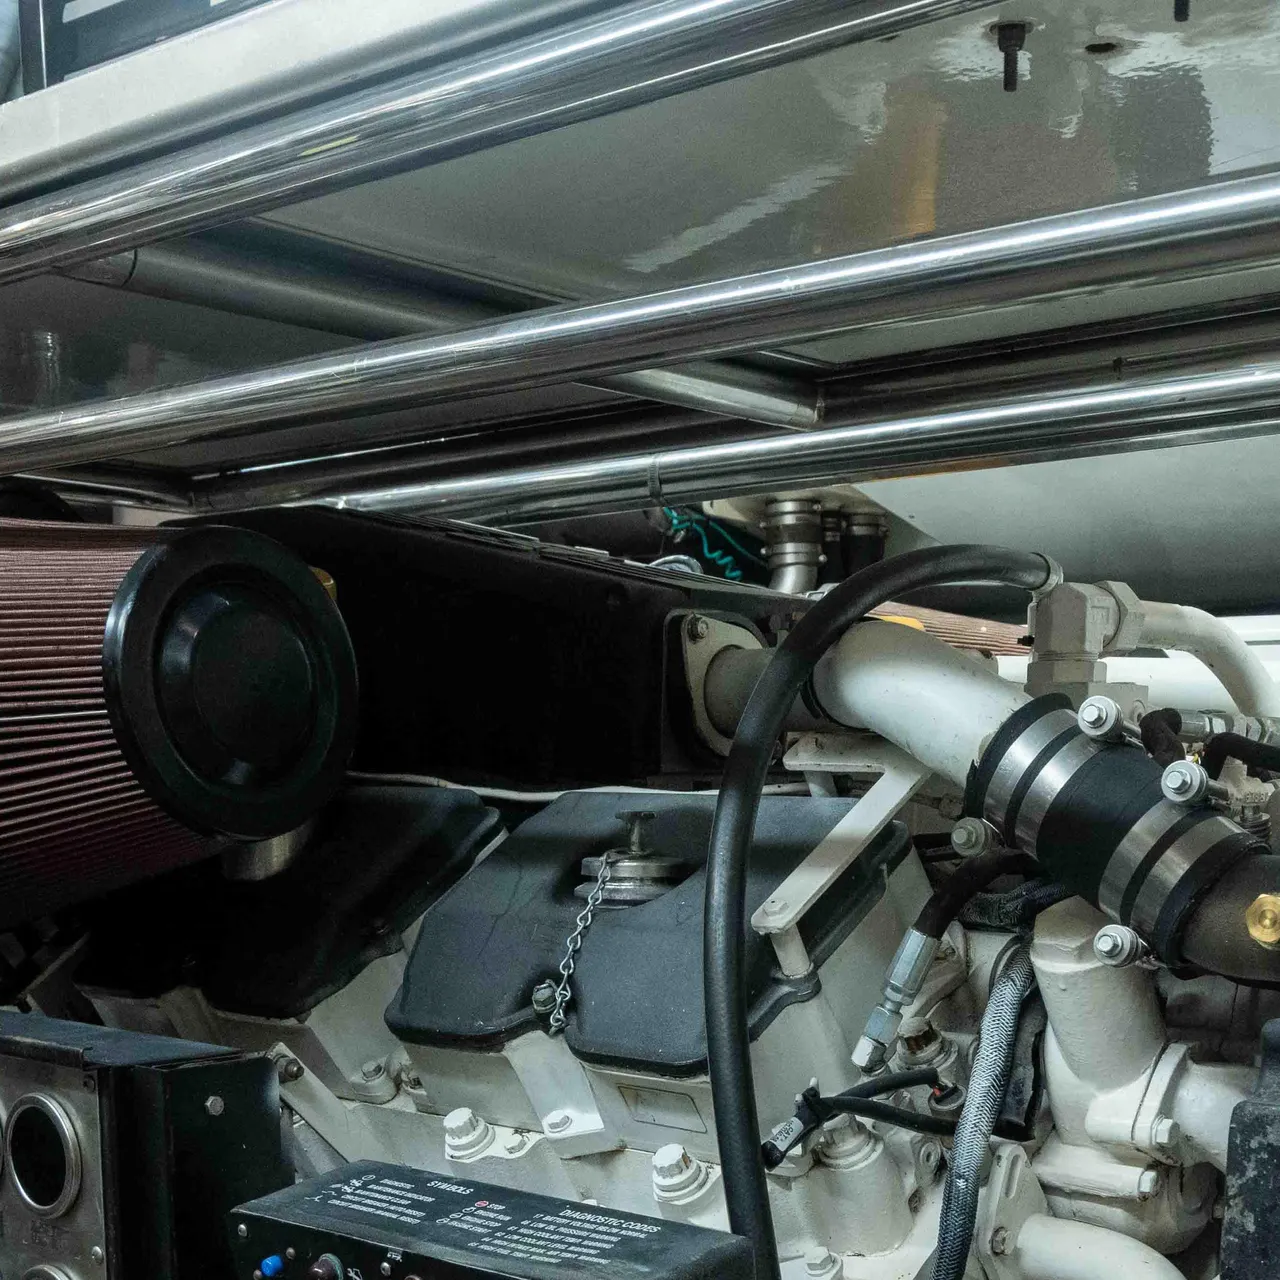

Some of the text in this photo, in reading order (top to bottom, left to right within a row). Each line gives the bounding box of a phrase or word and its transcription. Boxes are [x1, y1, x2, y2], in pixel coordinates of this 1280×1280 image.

[426, 1180, 474, 1196] SYMBOLS
[560, 1210, 661, 1232] DIAGNOSTIC CODES
